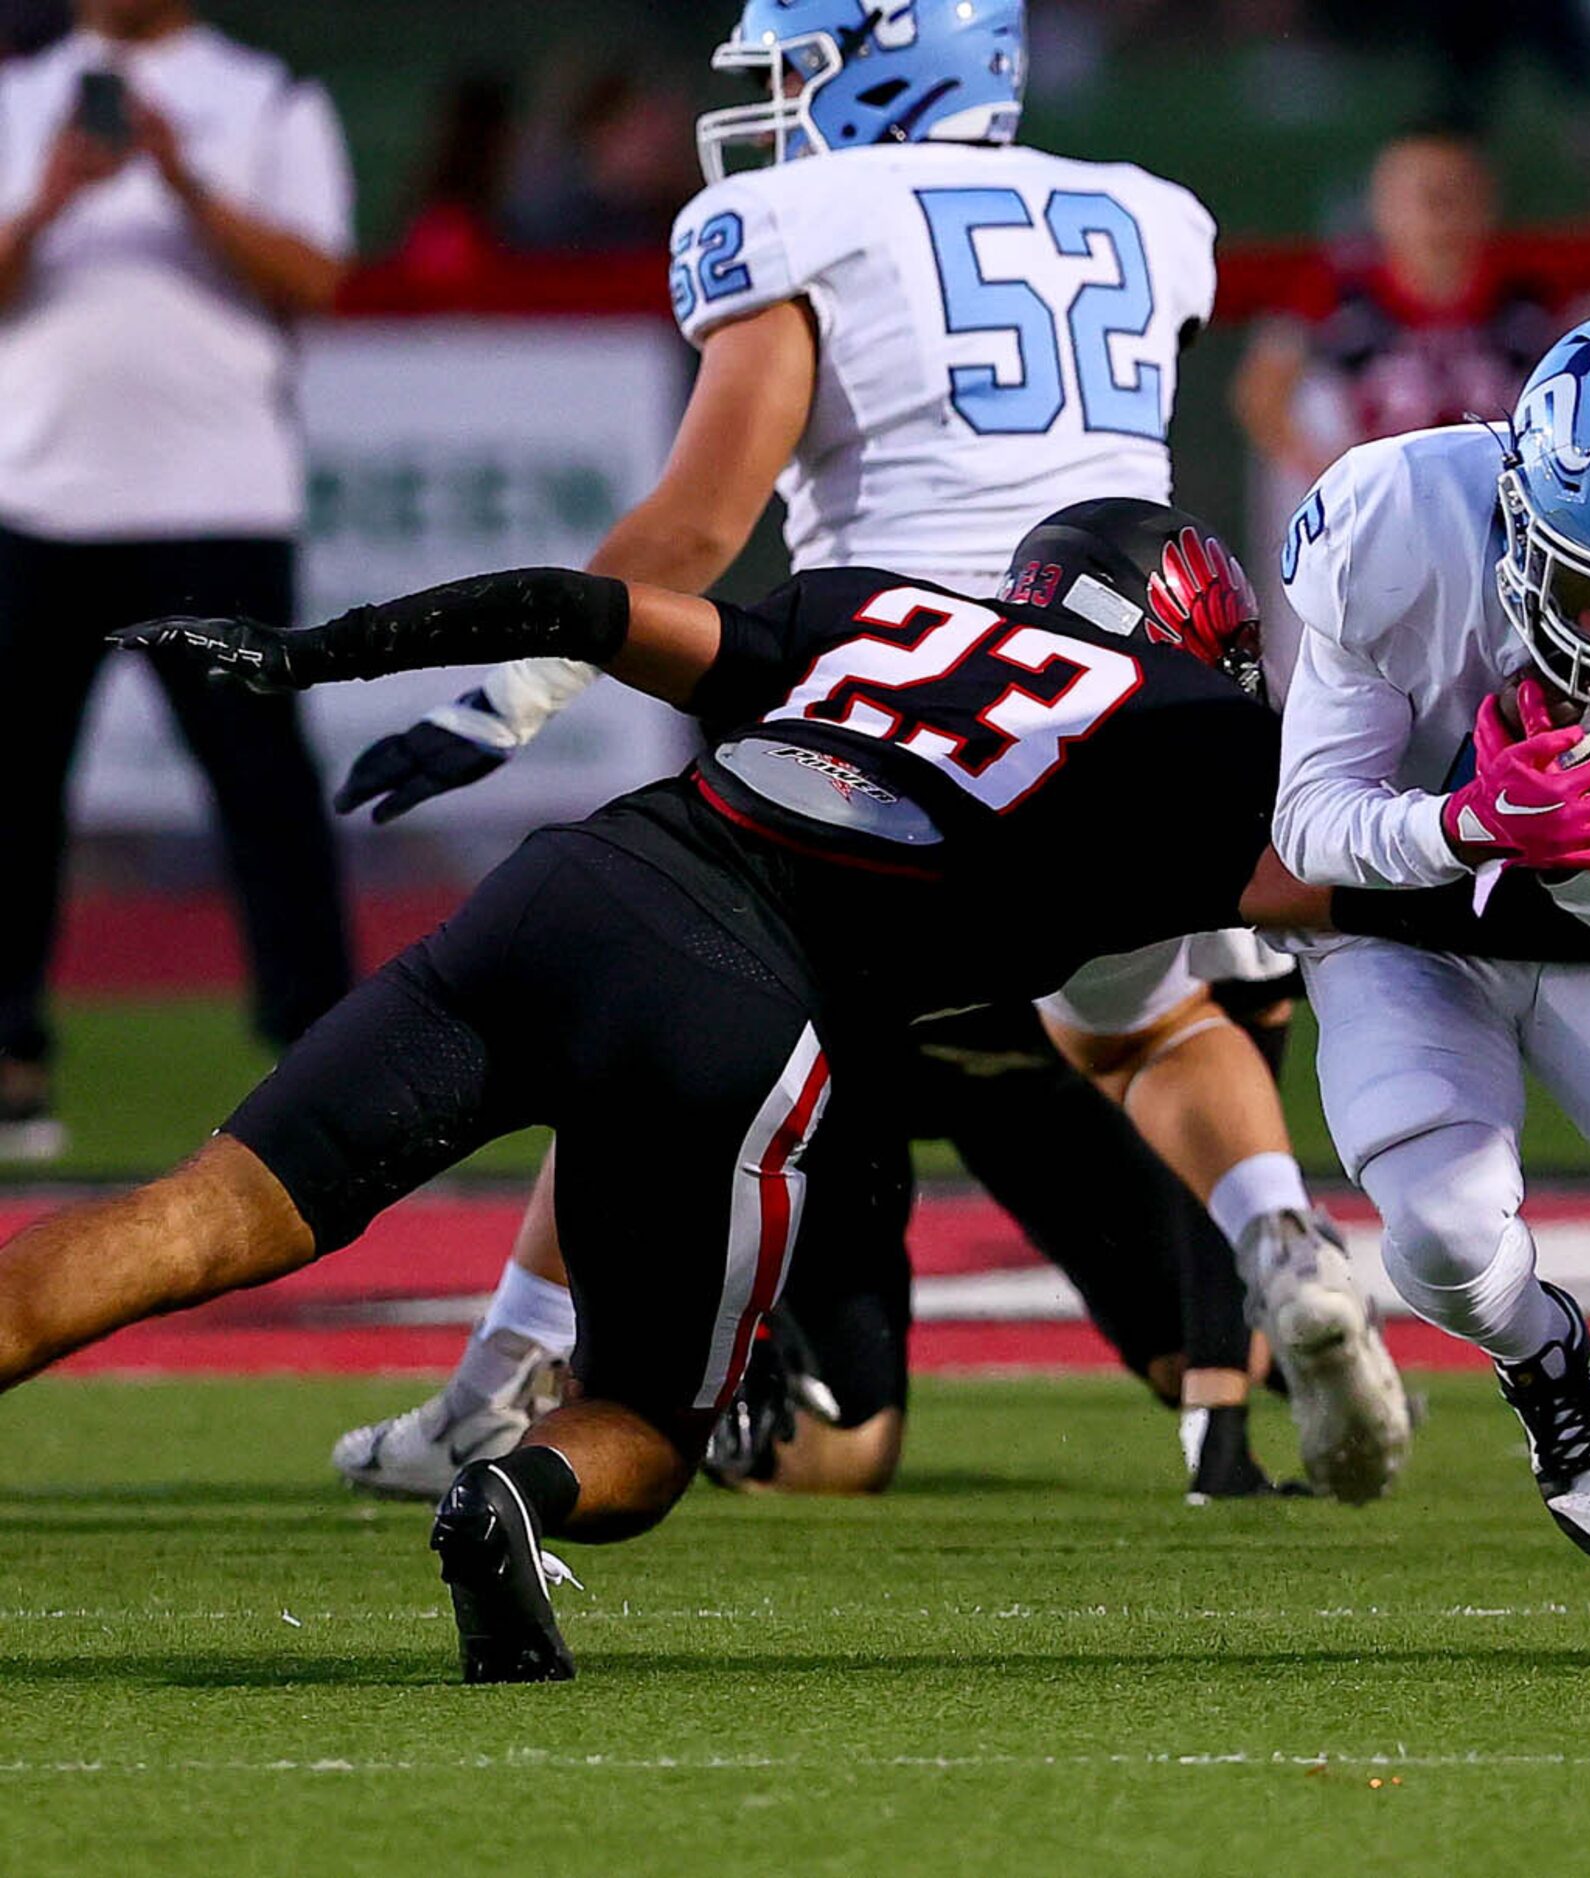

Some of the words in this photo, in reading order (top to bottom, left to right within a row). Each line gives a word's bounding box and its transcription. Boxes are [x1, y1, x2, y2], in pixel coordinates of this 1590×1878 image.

[668, 208, 753, 323] 52
[913, 188, 1168, 443] 52
[1008, 560, 1064, 608] 23
[762, 586, 1146, 816] 23
[766, 746, 898, 804] POWER
